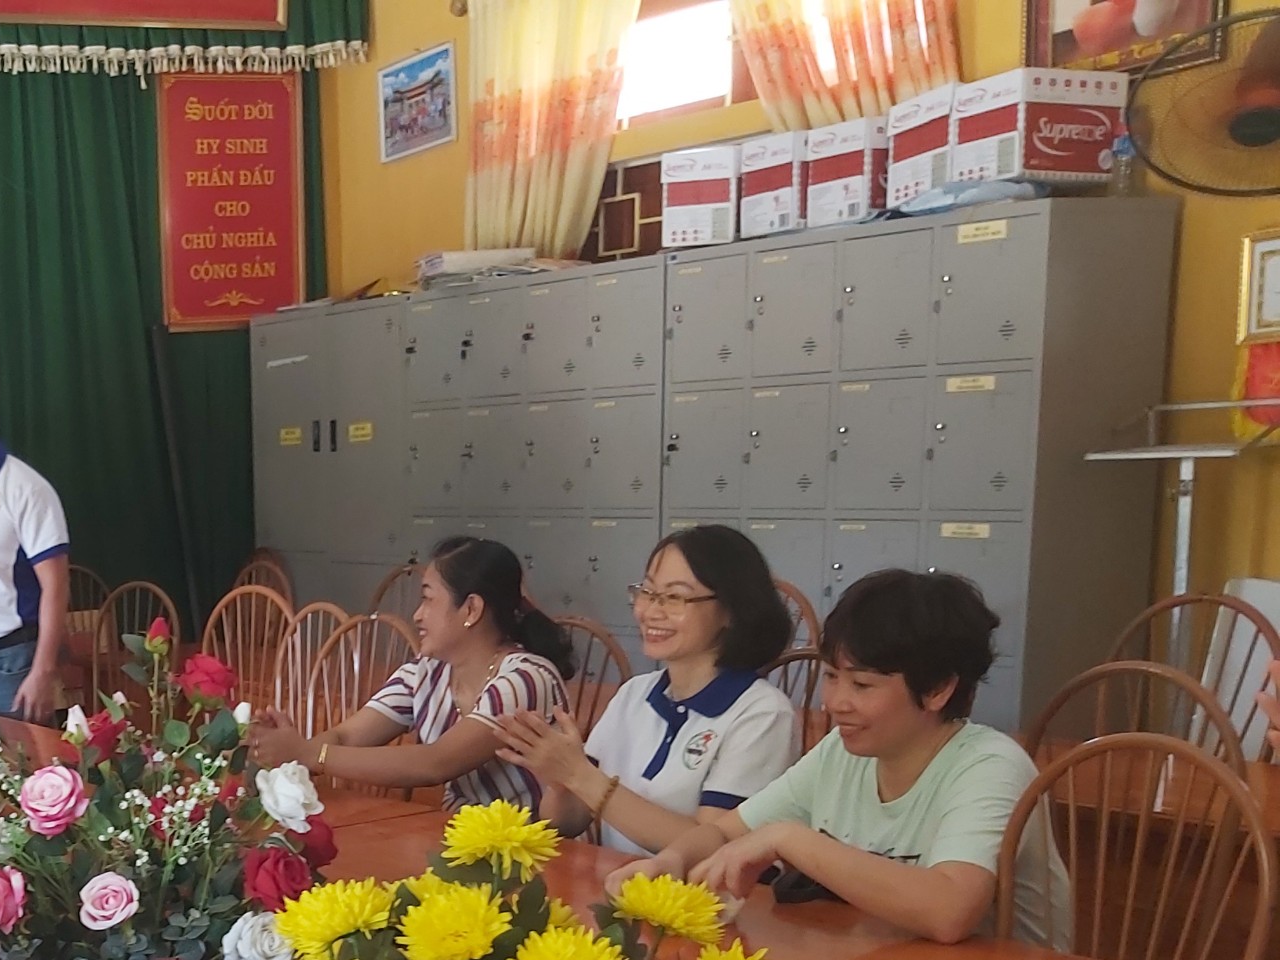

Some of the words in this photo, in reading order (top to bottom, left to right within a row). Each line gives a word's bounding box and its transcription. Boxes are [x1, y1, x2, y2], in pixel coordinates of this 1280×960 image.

[243, 99, 274, 120] ĐỜI
[1036, 117, 1107, 145] Supreme
[195, 138, 221, 154] HY
[225, 138, 268, 154] SINH
[185, 164, 235, 187] PHẤN
[239, 163, 275, 186] ĐẤU
[214, 201, 251, 217] CHO
[181, 225, 216, 249] CHỦ
[221, 227, 277, 248] NGHĨA
[190, 259, 237, 283] CỘNG
[241, 255, 276, 278] SẢN
